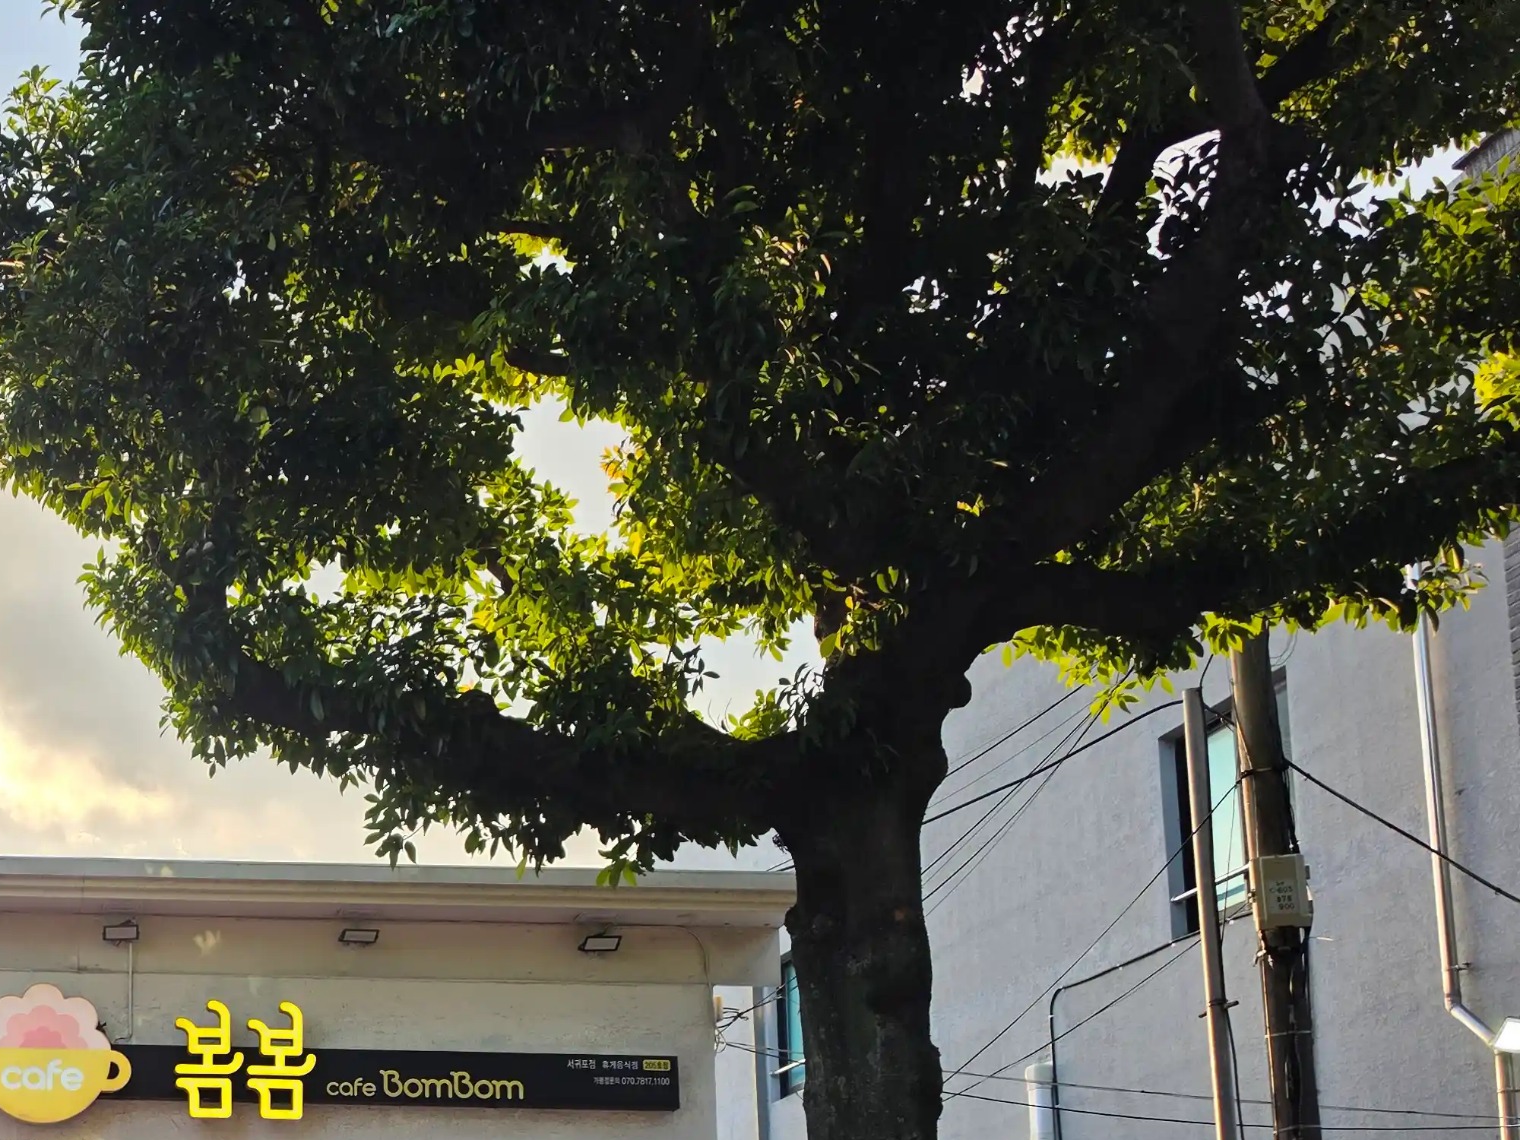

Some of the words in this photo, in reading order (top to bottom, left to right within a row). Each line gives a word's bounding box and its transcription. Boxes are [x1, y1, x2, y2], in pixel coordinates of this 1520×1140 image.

[1, 1058, 84, 1091] cafe
[175, 1000, 318, 1120] 봄봄
[567, 1059, 596, 1070] 서귀포점
[602, 1060, 639, 1070] 휴게음식점
[326, 1077, 377, 1097] cafe
[381, 1069, 525, 1099] BomBom
[621, 1077, 670, 1085] 070.7817.1100
